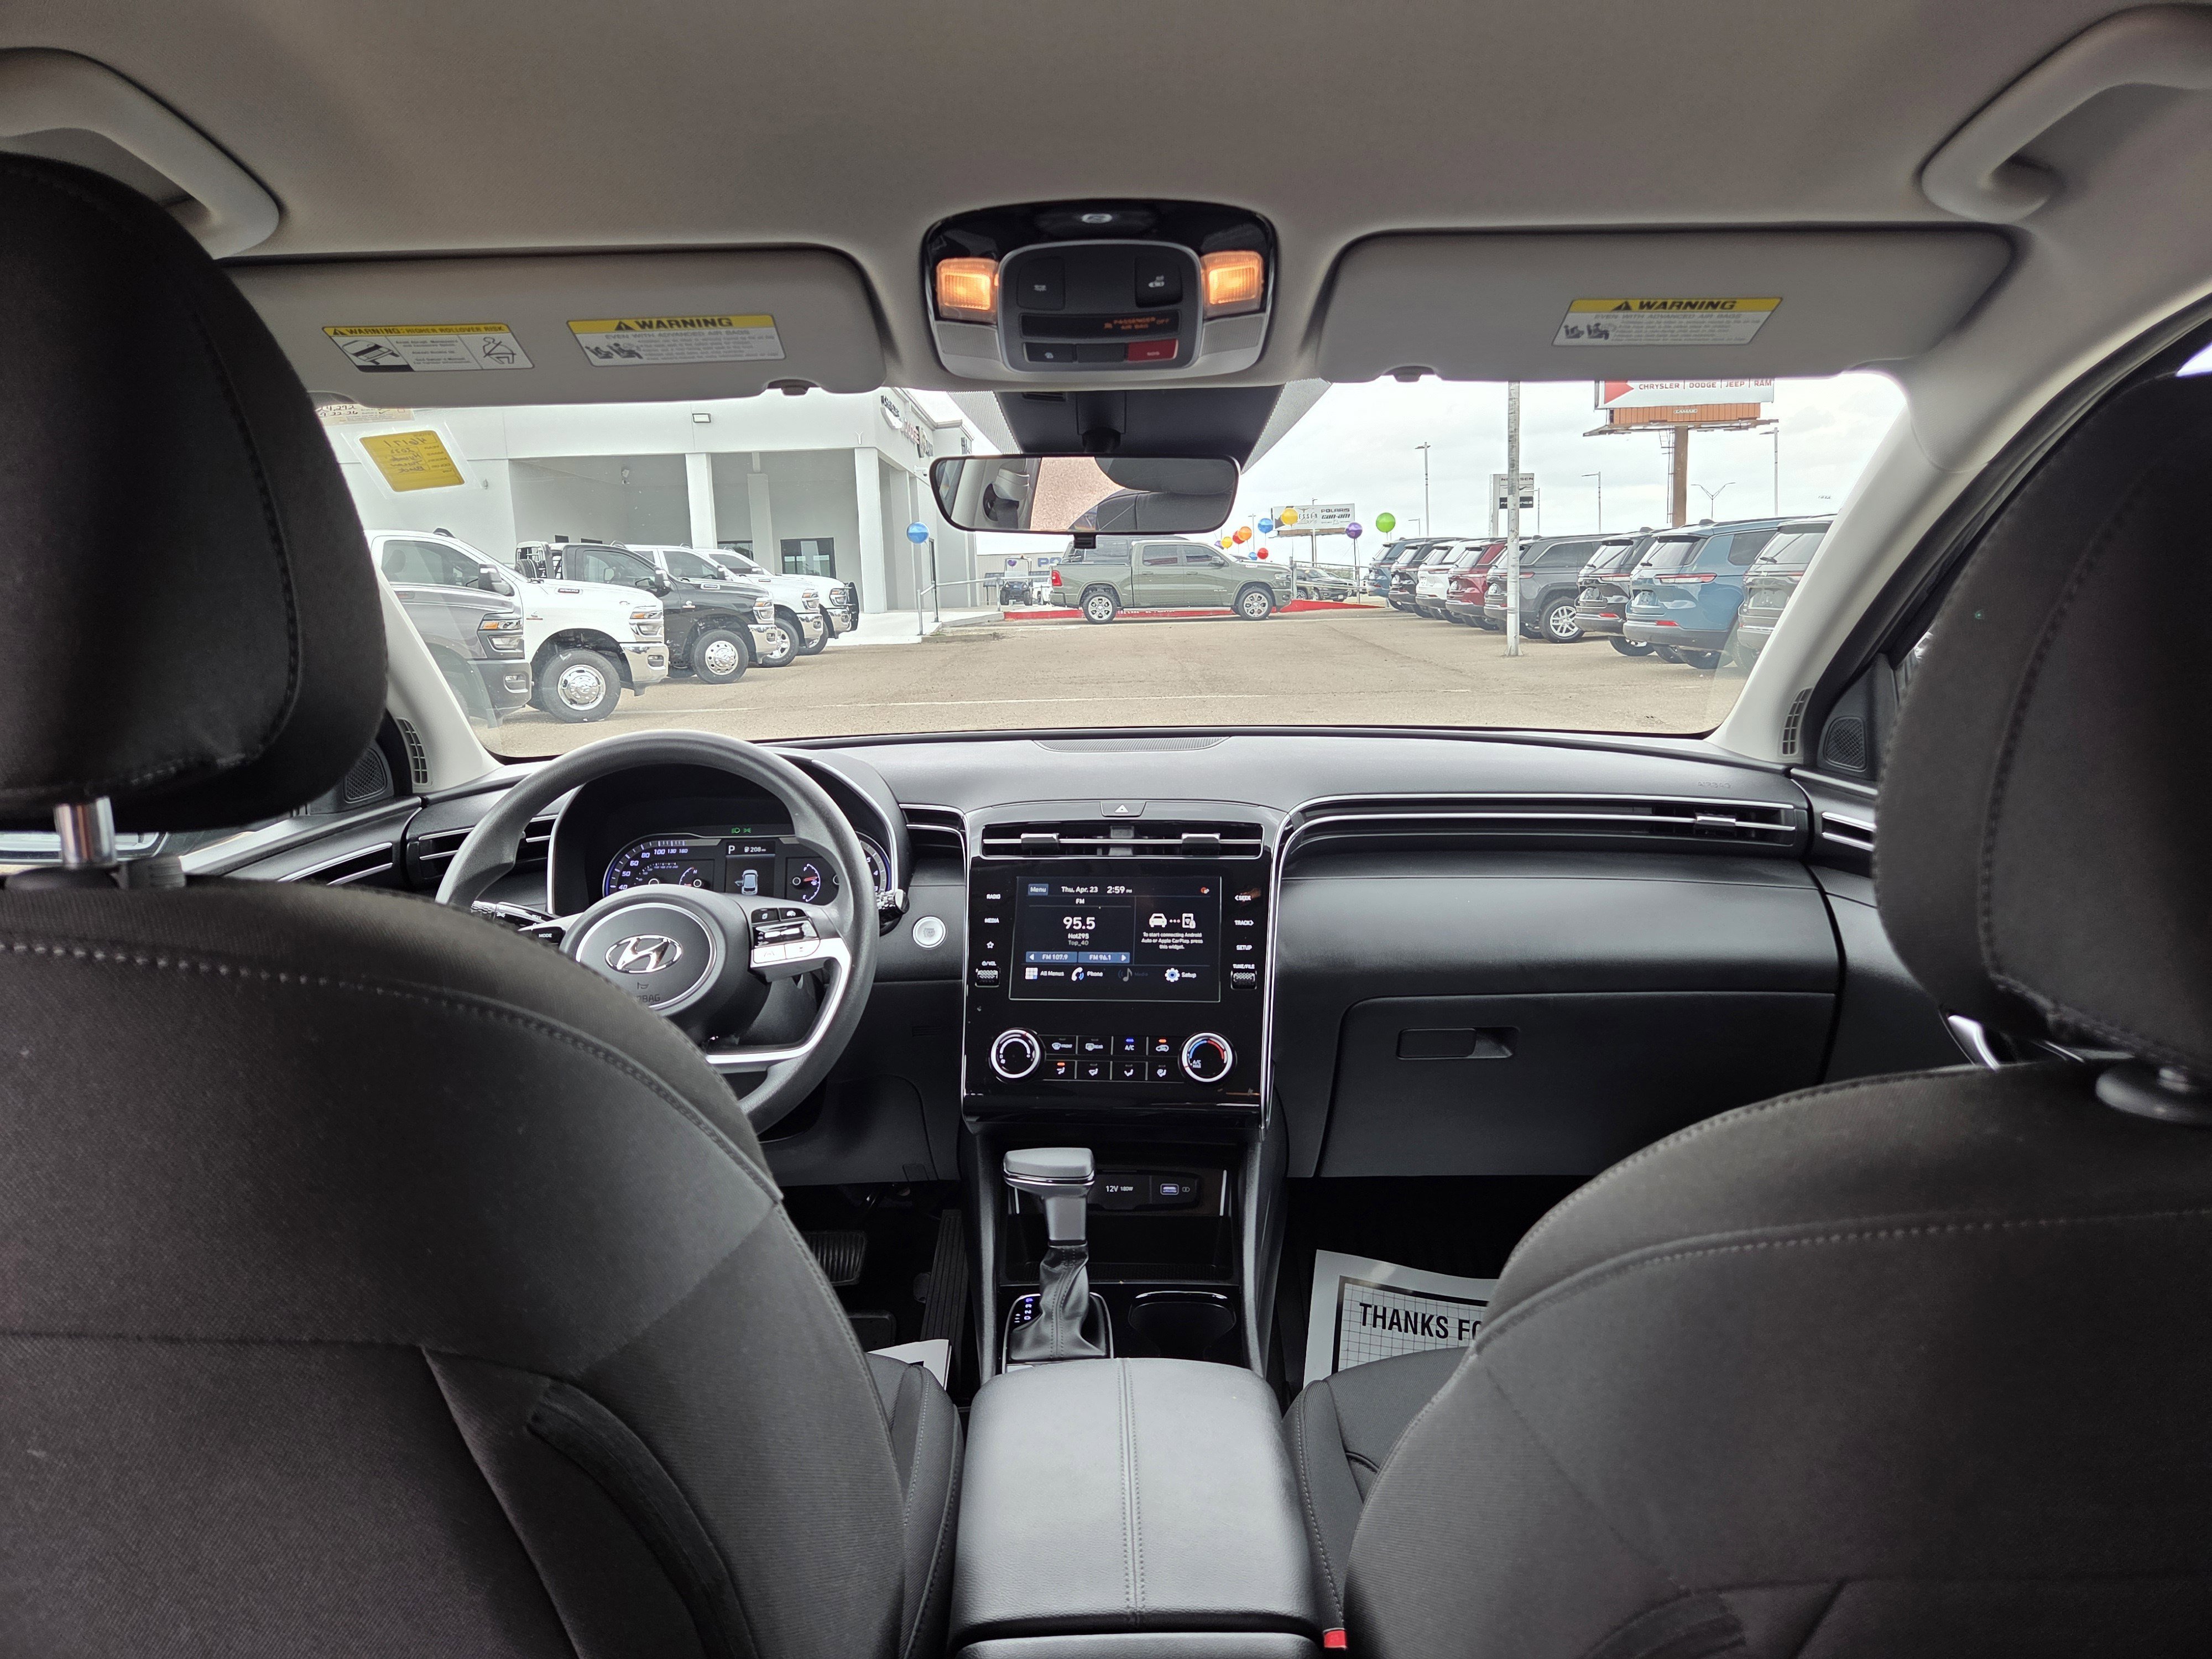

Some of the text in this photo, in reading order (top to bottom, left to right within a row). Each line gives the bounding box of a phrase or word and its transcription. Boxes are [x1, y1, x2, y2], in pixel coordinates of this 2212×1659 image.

[1637, 300, 1738, 310] WARNING
[634, 317, 733, 330] WARNING
[728, 846, 735, 854] P
[1063, 916, 1095, 930] 95.5
[1359, 1302, 1482, 1340] THANKS FO
